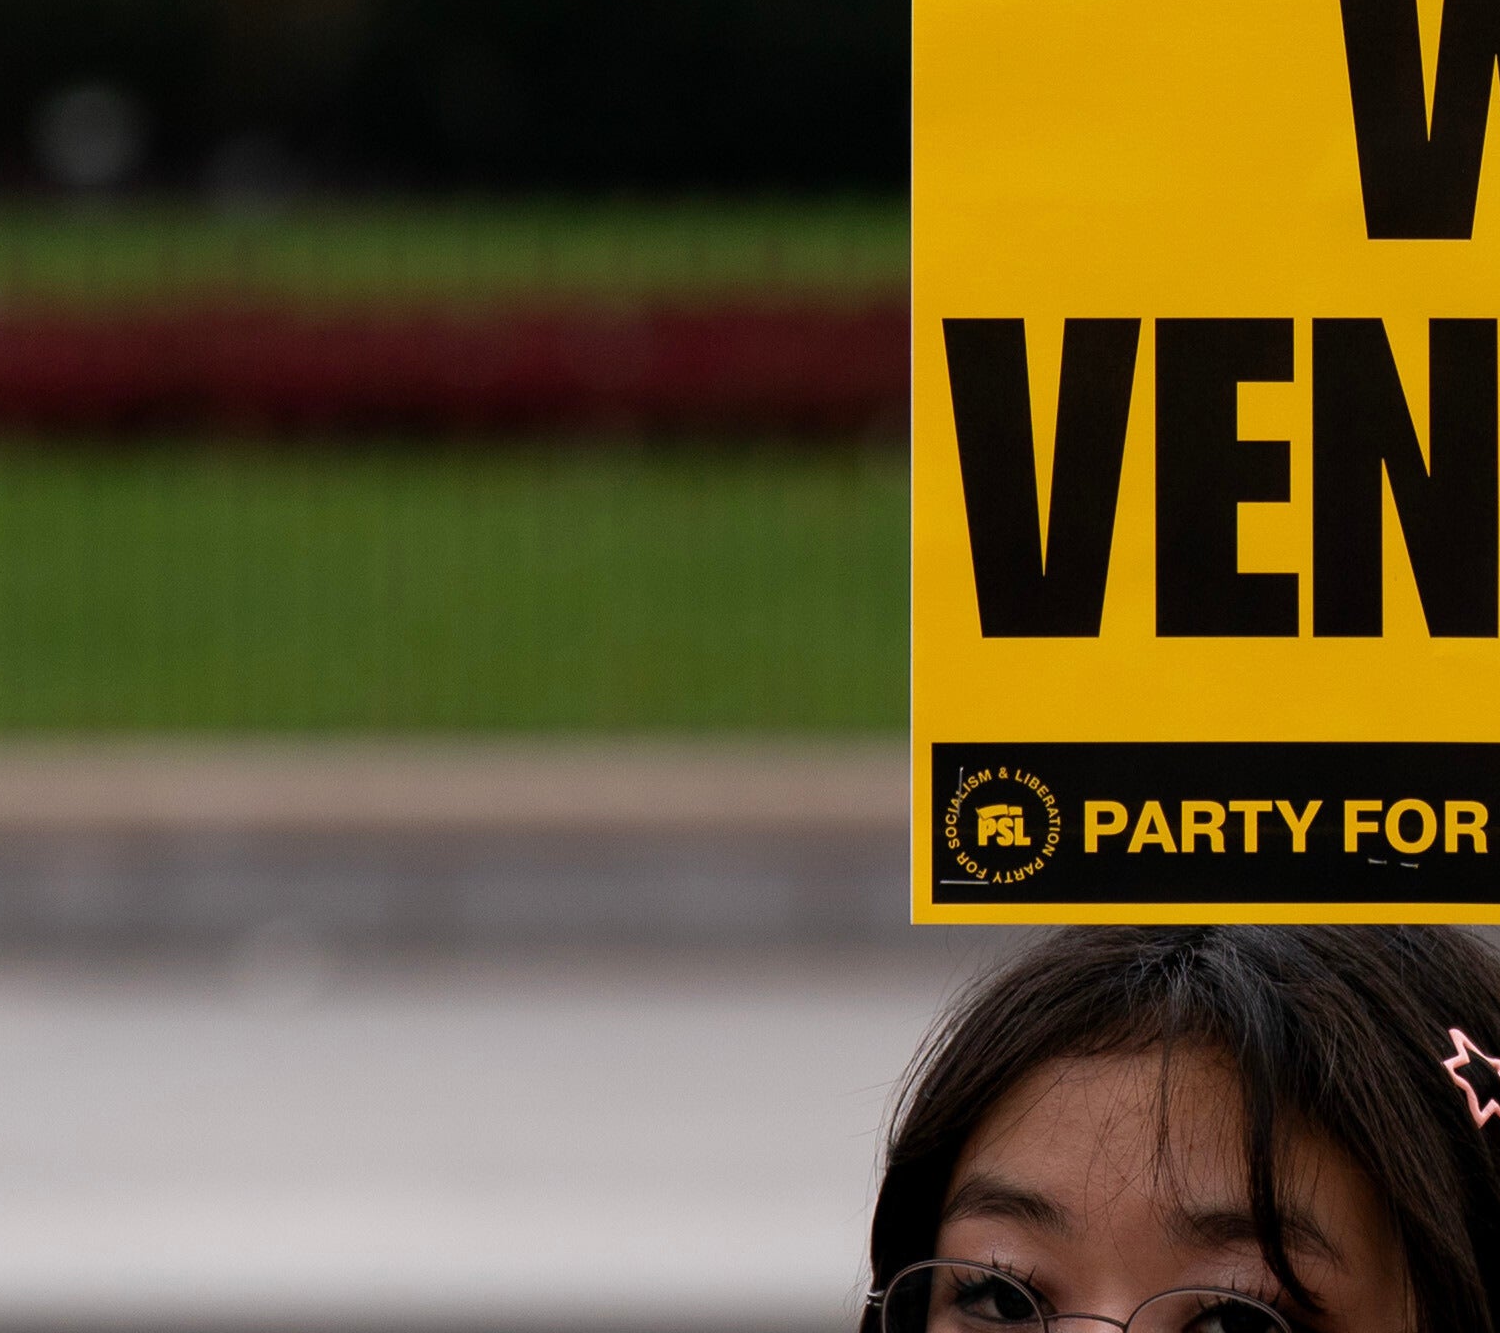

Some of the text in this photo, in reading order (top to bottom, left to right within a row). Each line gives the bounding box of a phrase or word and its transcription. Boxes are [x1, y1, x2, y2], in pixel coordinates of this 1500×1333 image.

[945, 767, 1061, 883] PARTY FOR SOCIALISM & LIBERATION
[977, 817, 1031, 847] PSL
[1085, 800, 1322, 853] PARTY
[1345, 799, 1488, 853] FOR
